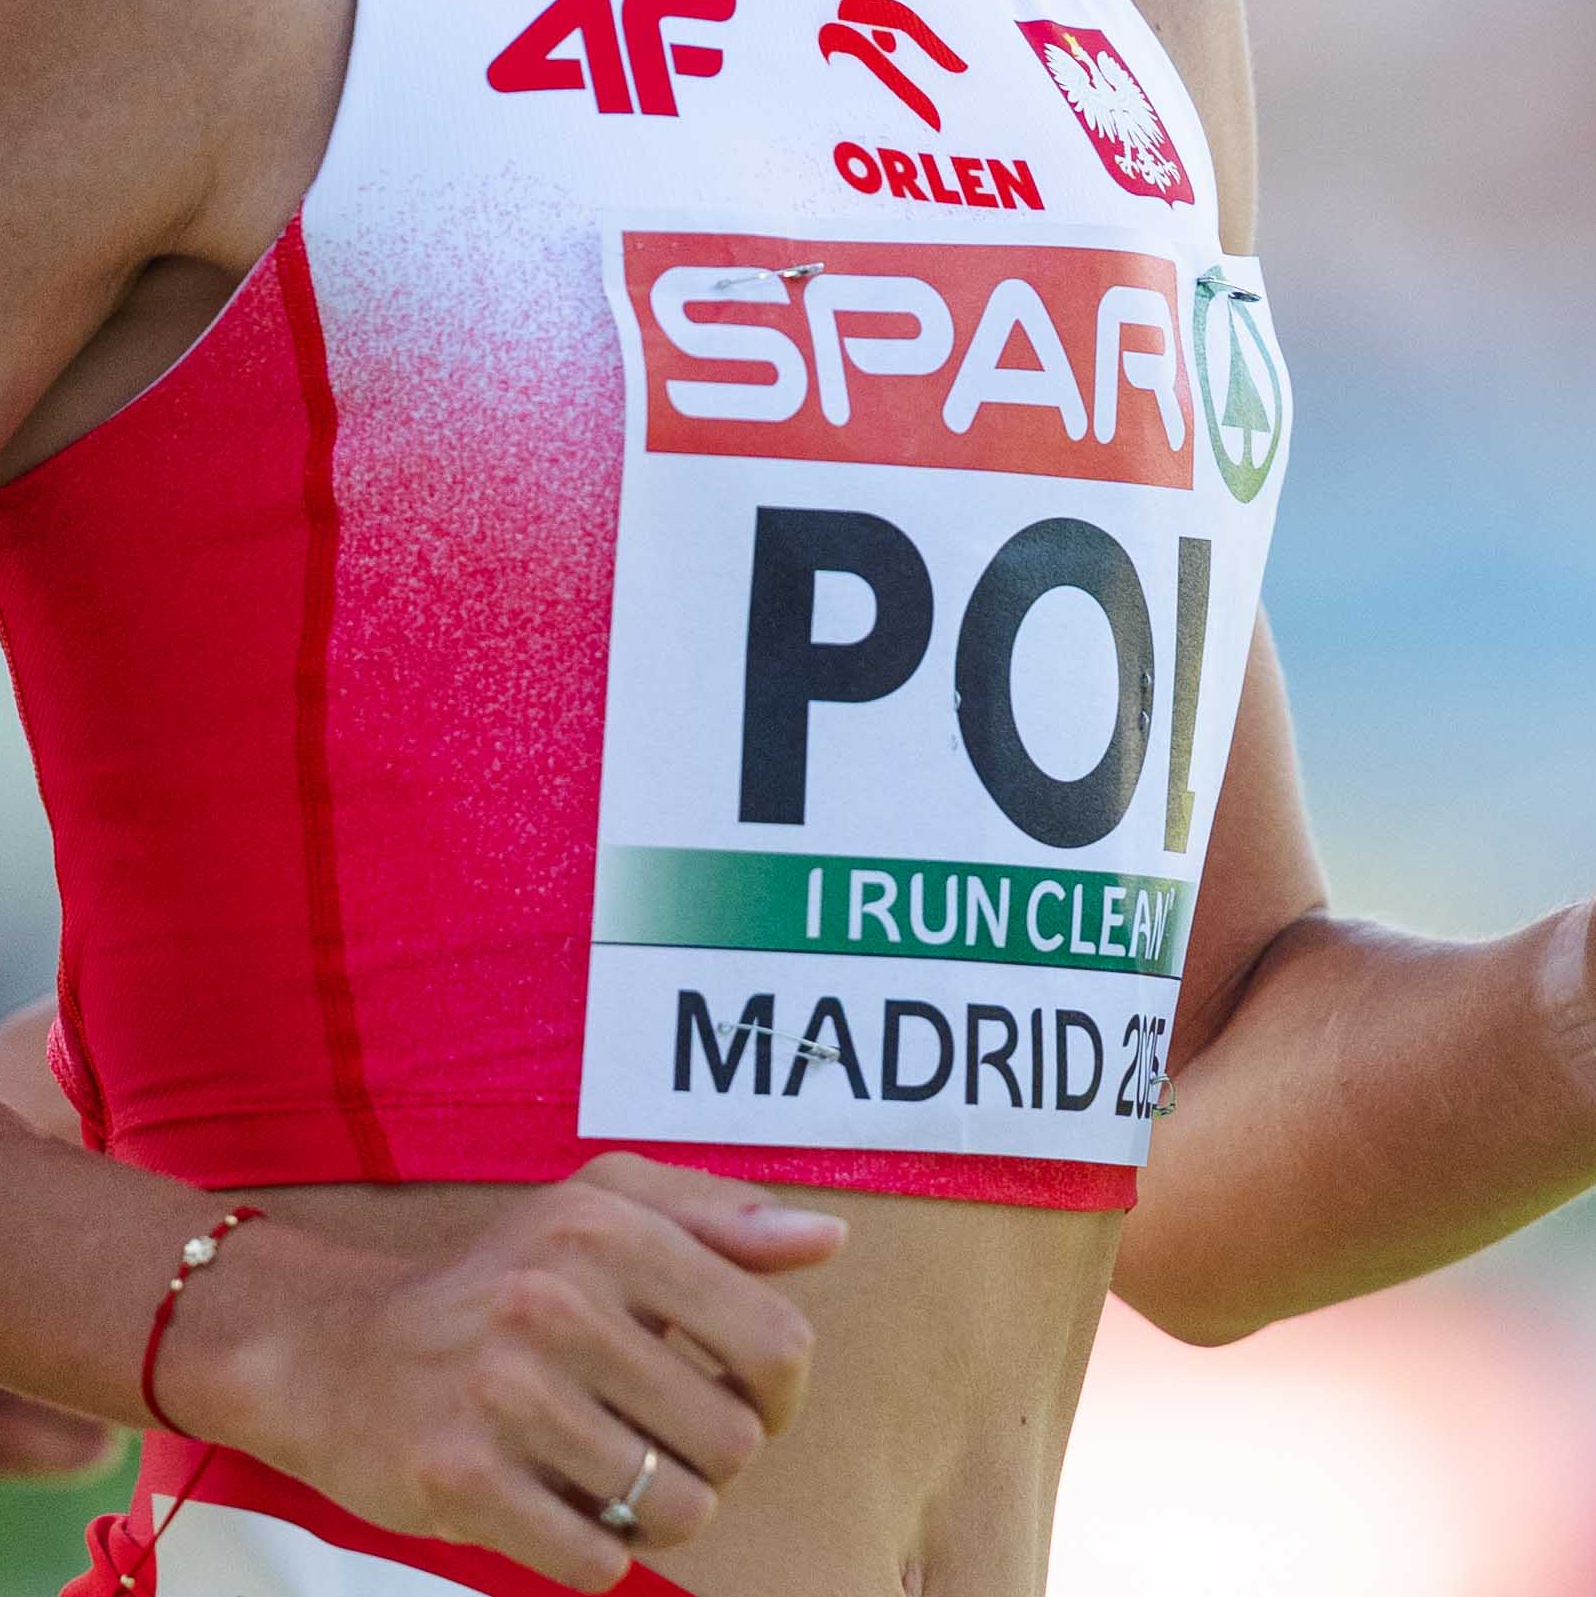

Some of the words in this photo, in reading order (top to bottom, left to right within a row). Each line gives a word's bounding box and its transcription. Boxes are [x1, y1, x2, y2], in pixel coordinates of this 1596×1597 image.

[834, 141, 1045, 211] ORLEN
[649, 265, 1186, 452] SPAR
[805, 866, 824, 939] I
[848, 868, 1009, 949] RUN
[673, 989, 1104, 1112] MADRID
